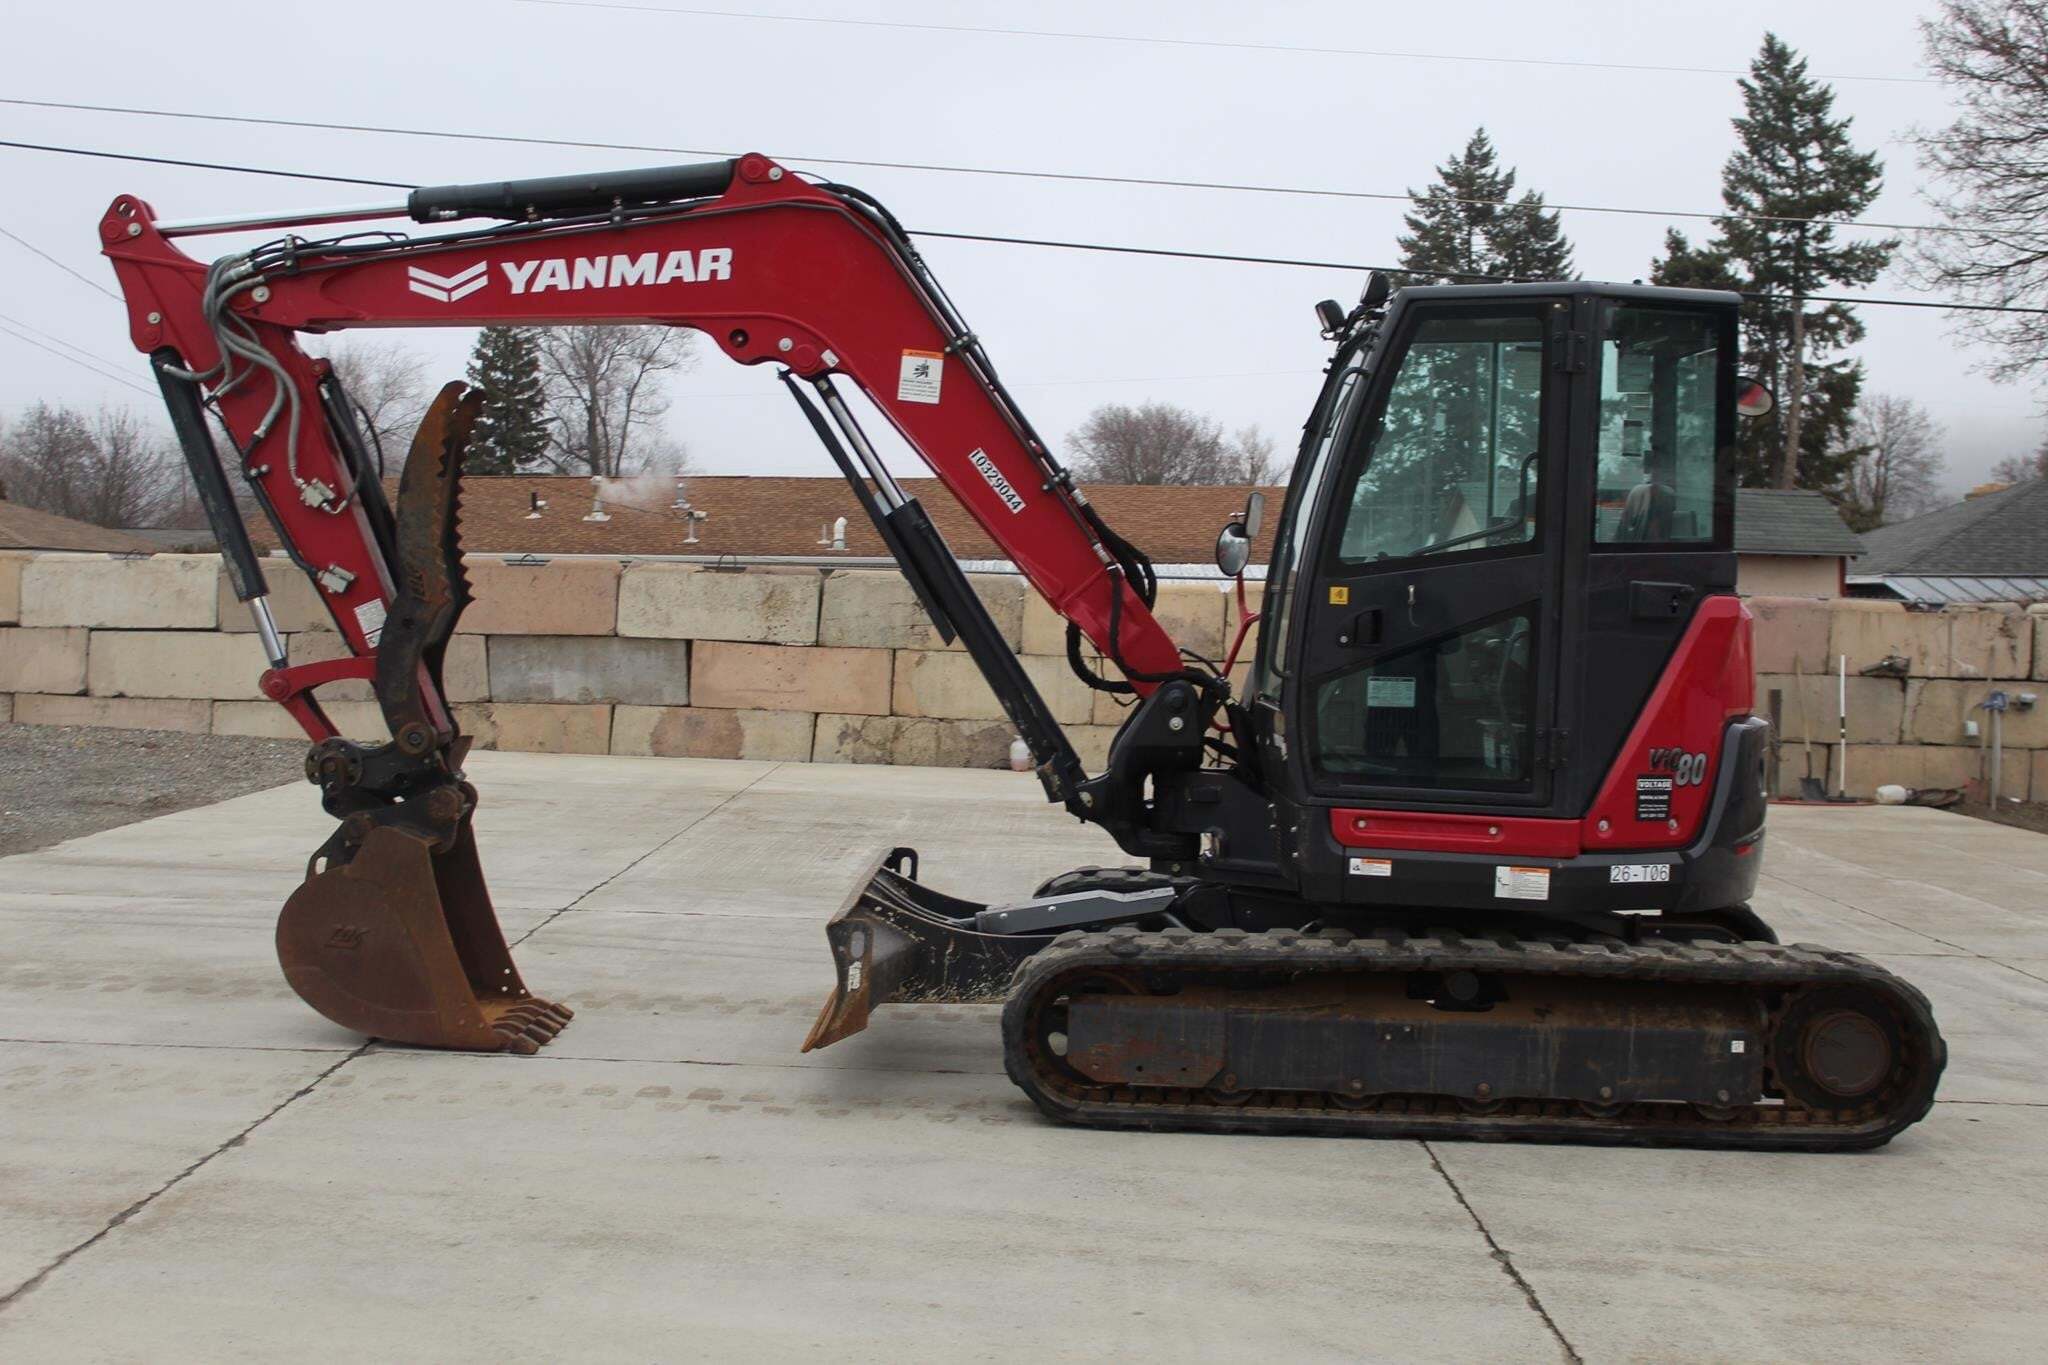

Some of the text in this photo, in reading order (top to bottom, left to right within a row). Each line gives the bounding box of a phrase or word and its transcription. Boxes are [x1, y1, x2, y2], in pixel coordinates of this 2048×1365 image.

[500, 247, 733, 294] YANMAR
[971, 450, 1022, 510] 10329044
[1612, 865, 1669, 882] 26-T06
